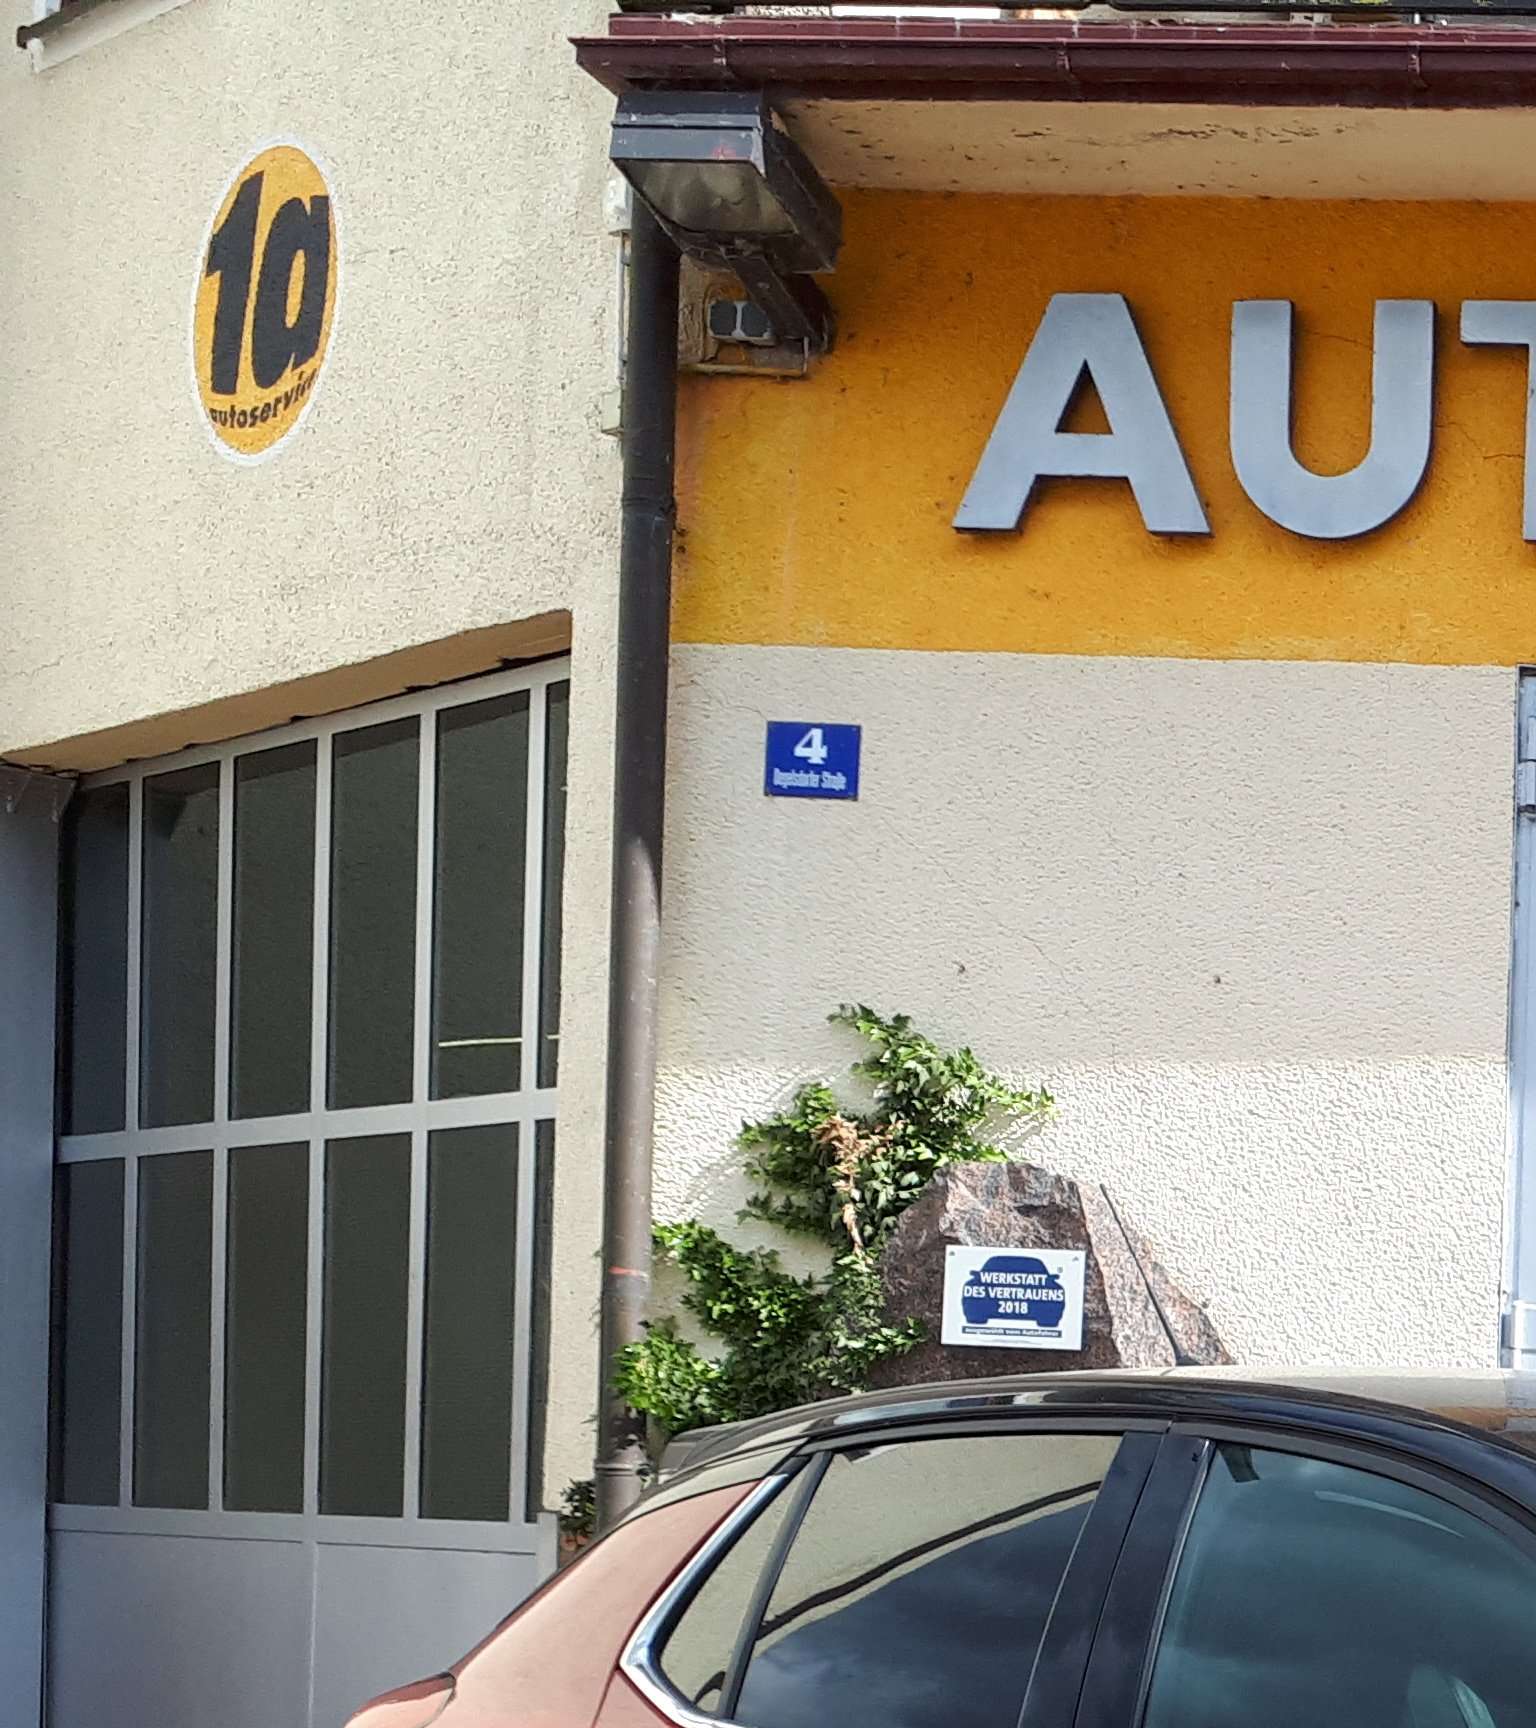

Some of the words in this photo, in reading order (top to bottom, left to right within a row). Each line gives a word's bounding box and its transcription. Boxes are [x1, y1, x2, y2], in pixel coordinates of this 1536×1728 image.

[206, 170, 330, 395] 1a
[793, 727, 828, 765] 4
[979, 1271, 1048, 1286] WERKSTATT
[963, 1286, 986, 1298] DES
[988, 1287, 1065, 1301] VERTRAUENS
[997, 1301, 1029, 1315] 2018
